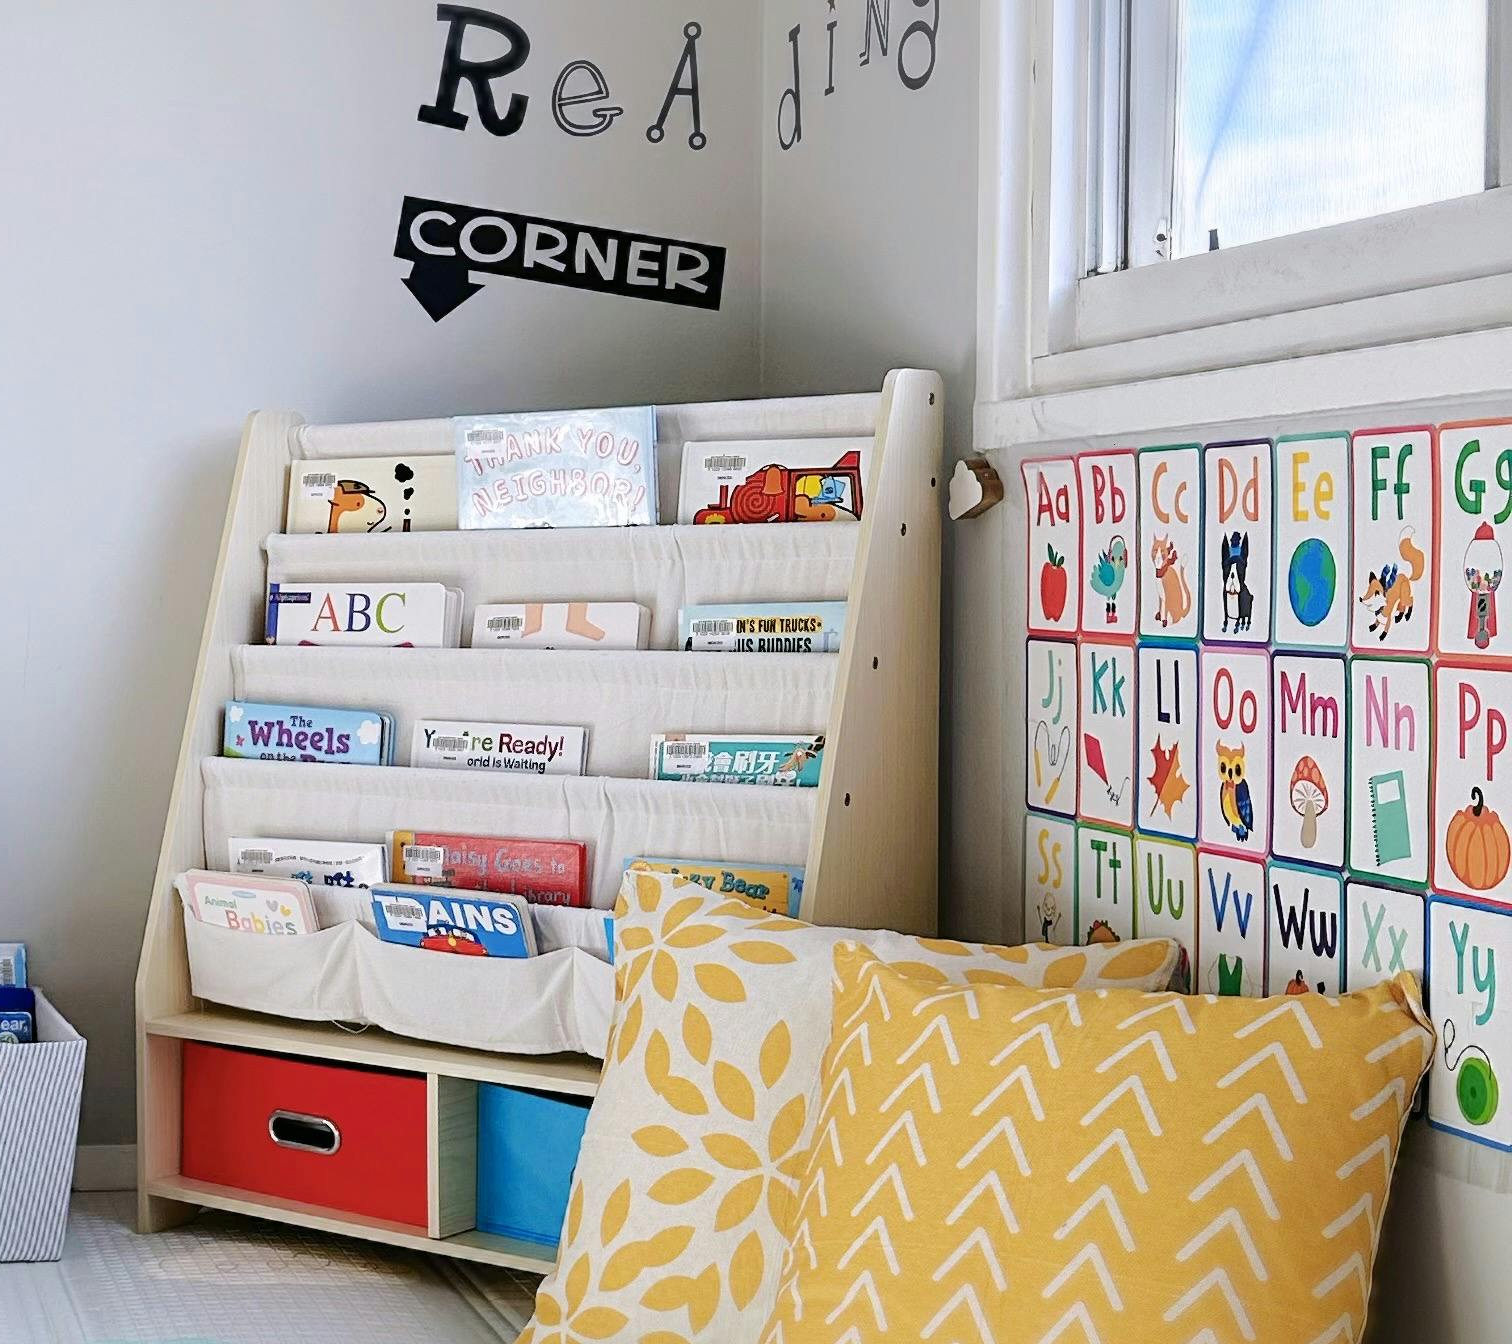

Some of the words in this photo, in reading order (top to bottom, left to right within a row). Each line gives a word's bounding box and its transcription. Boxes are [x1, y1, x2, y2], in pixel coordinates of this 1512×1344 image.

[409, 209, 710, 294] CORNER
[578, 428, 641, 473] YOU,
[472, 469, 646, 517] NEIGHBOR!
[1036, 471, 1070, 528] Aa
[1092, 465, 1126, 525] Bb
[1151, 461, 1189, 525] Cc
[1218, 456, 1259, 525] Dd
[1292, 452, 1334, 522] Ee
[1371, 443, 1413, 521] Ff
[310, 592, 406, 633] ABC
[758, 619, 776, 634] FUN
[779, 618, 816, 633] TRUCKS
[290, 716, 313, 728] The
[1042, 649, 1064, 725] Jj
[1091, 651, 1126, 718] Kk
[1213, 667, 1258, 734] Oo
[1279, 671, 1338, 738] Mm
[1365, 674, 1415, 752] Nn
[1458, 681, 1508, 782] Pp
[248, 720, 351, 755] Wheels
[498, 733, 565, 762] Ready!
[467, 756, 491, 768] orld
[504, 757, 546, 774] Waiting
[495, 847, 543, 874] Goes
[551, 857, 567, 874] to
[720, 869, 771, 901] Bear
[204, 896, 237, 909] Animal
[225, 909, 298, 935] Babies
[1037, 827, 1063, 889] Ss
[1090, 838, 1122, 904] Tt
[1147, 851, 1185, 920] Uu
[1207, 867, 1252, 939] Vv
[1273, 883, 1338, 959] Ww
[1361, 900, 1408, 974] Xx
[1449, 920, 1495, 1026] Yy
